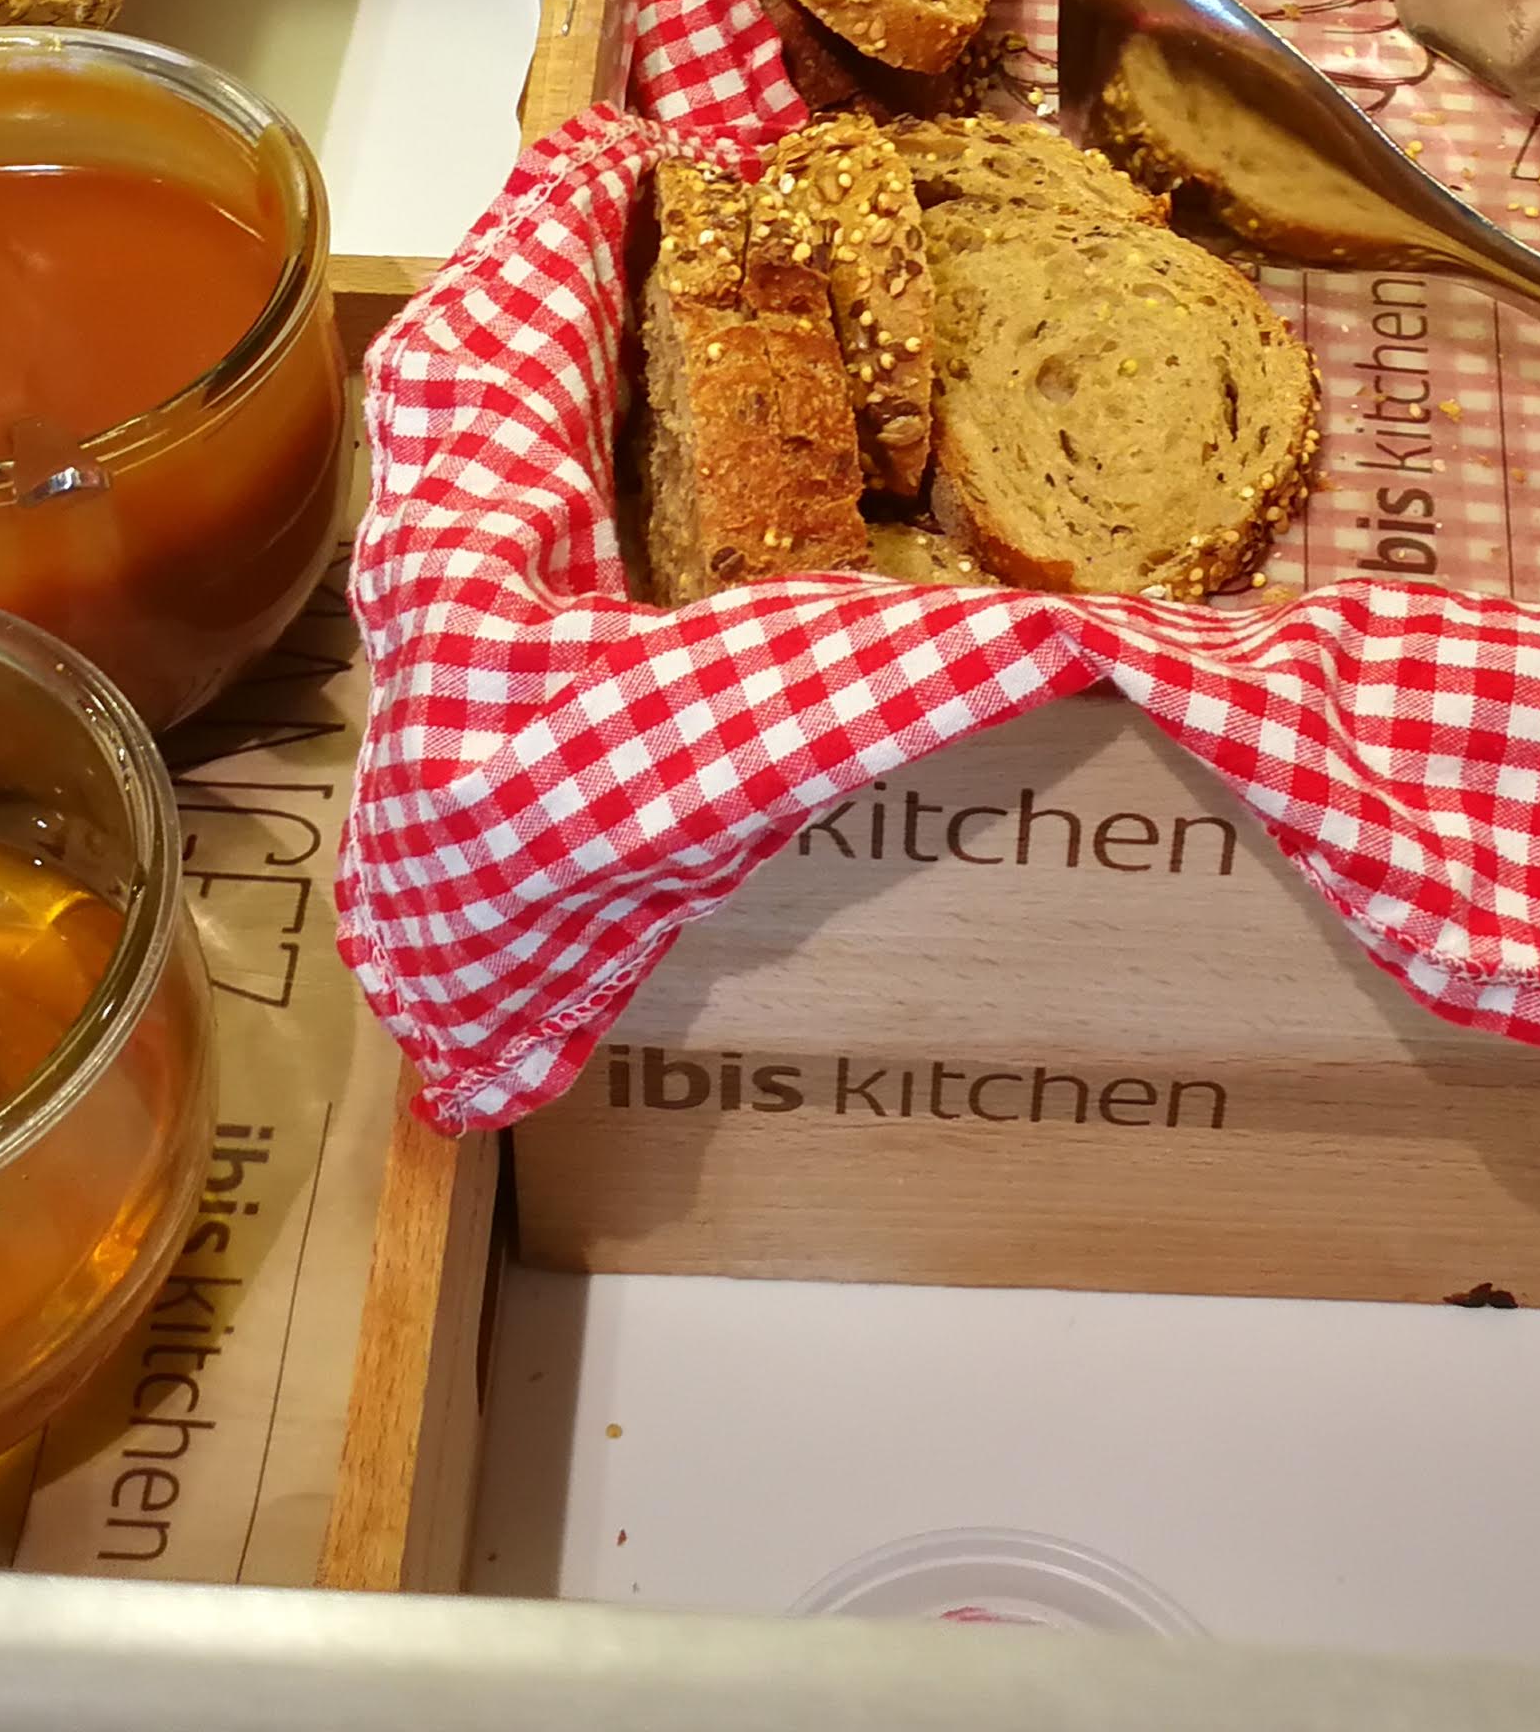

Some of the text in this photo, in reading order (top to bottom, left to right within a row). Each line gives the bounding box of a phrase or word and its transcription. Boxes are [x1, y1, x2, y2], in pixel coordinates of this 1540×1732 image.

[1354, 277, 1440, 576] bis kitchen
[799, 781, 1239, 876] kitchen
[608, 1044, 1229, 1129] ibis kitchen
[97, 1274, 244, 1566] kitchen
